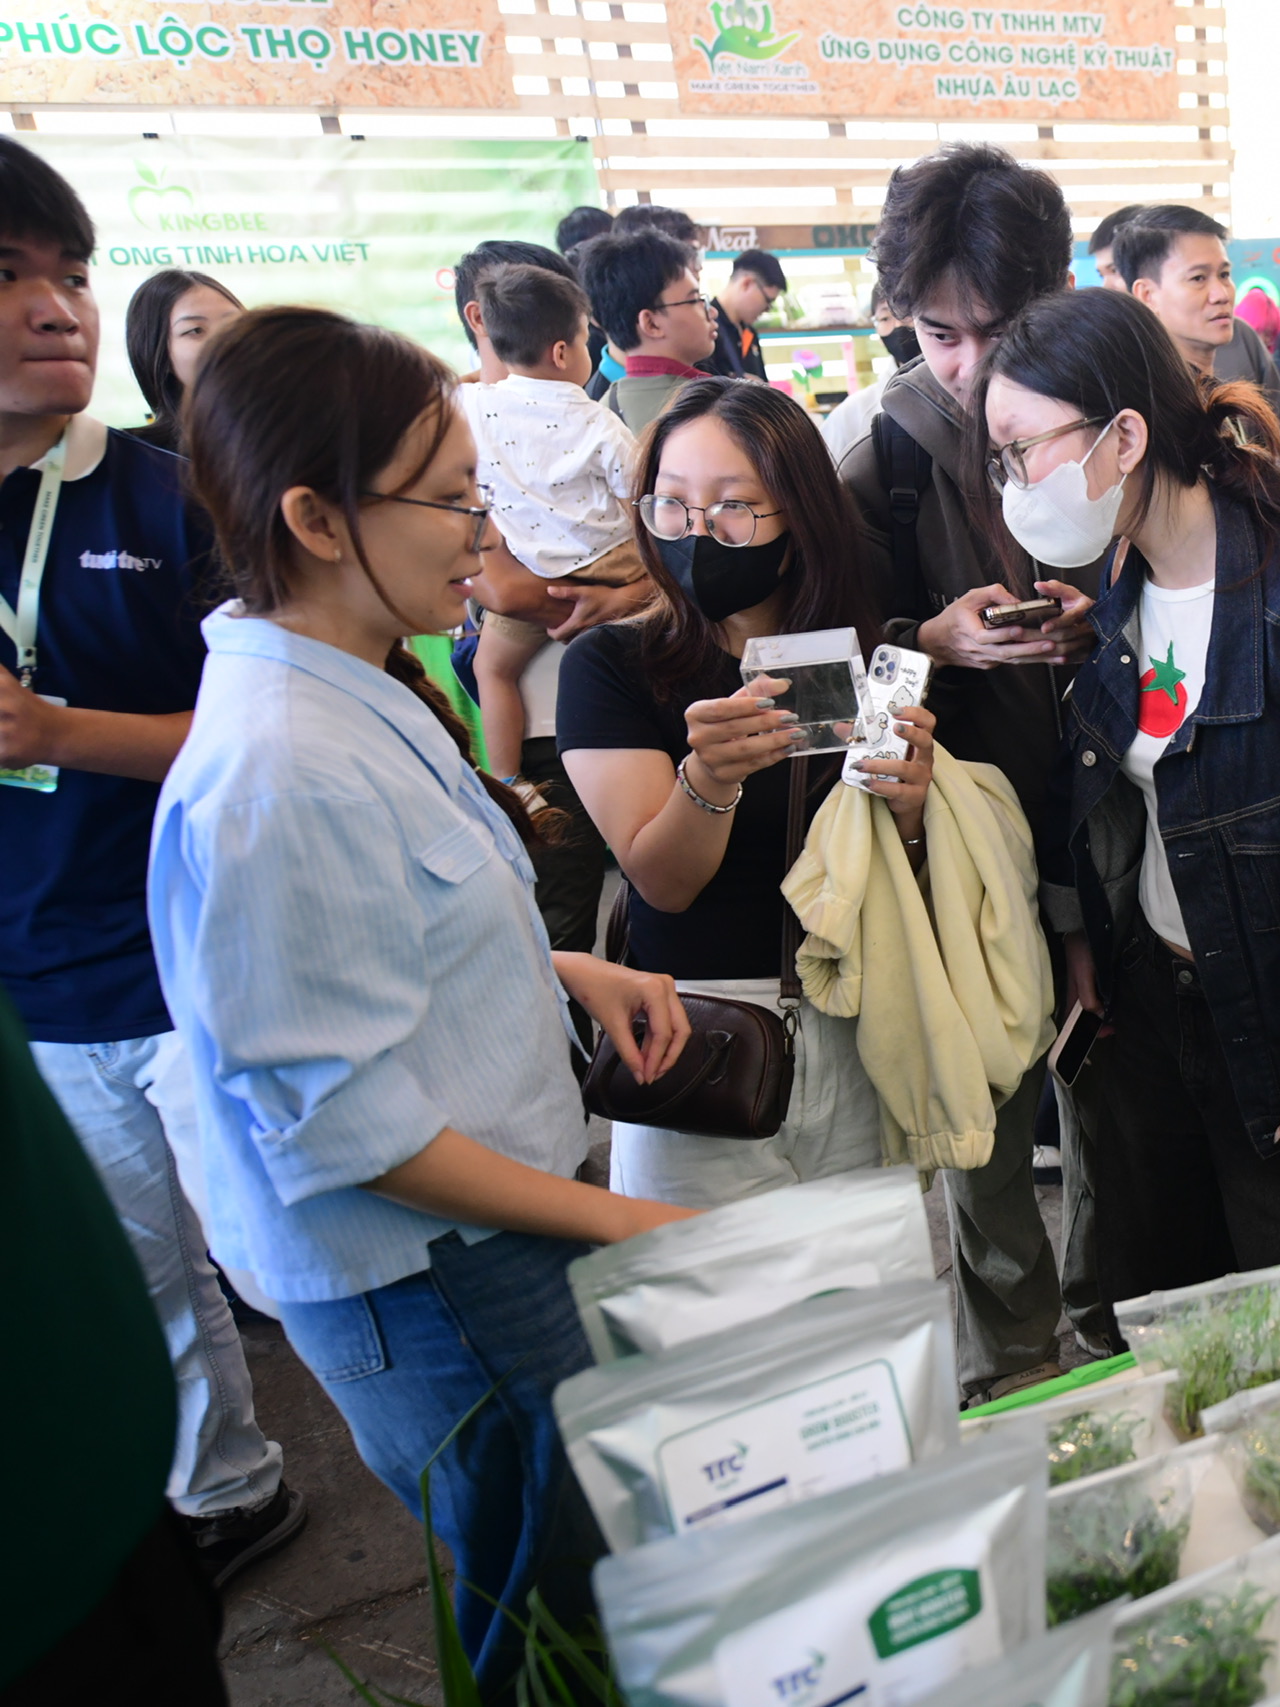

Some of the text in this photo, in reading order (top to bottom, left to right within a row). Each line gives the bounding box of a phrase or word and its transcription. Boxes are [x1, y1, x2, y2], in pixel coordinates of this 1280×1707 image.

[897, 4, 1102, 33] CÔNG TY TNHH MTV
[135, 17, 230, 66] LỘC
[241, 28, 331, 68] THỌ
[344, 31, 480, 63] HONEY
[821, 35, 870, 59] ỨNG
[878, 42, 941, 66] DỤNG
[948, 40, 1014, 64] CÔNG
[1021, 43, 1076, 70] NGHỆ
[1114, 46, 1171, 73] THUẬT
[937, 74, 1077, 103] NHỰA ÂU LẠC
[160, 212, 267, 232] KINGBEE
[110, 246, 172, 265] ONG
[178, 244, 243, 264] TINH
[248, 244, 306, 263] HOA
[313, 240, 371, 266] VIỆT
[702, 1454, 743, 1483] TTC
